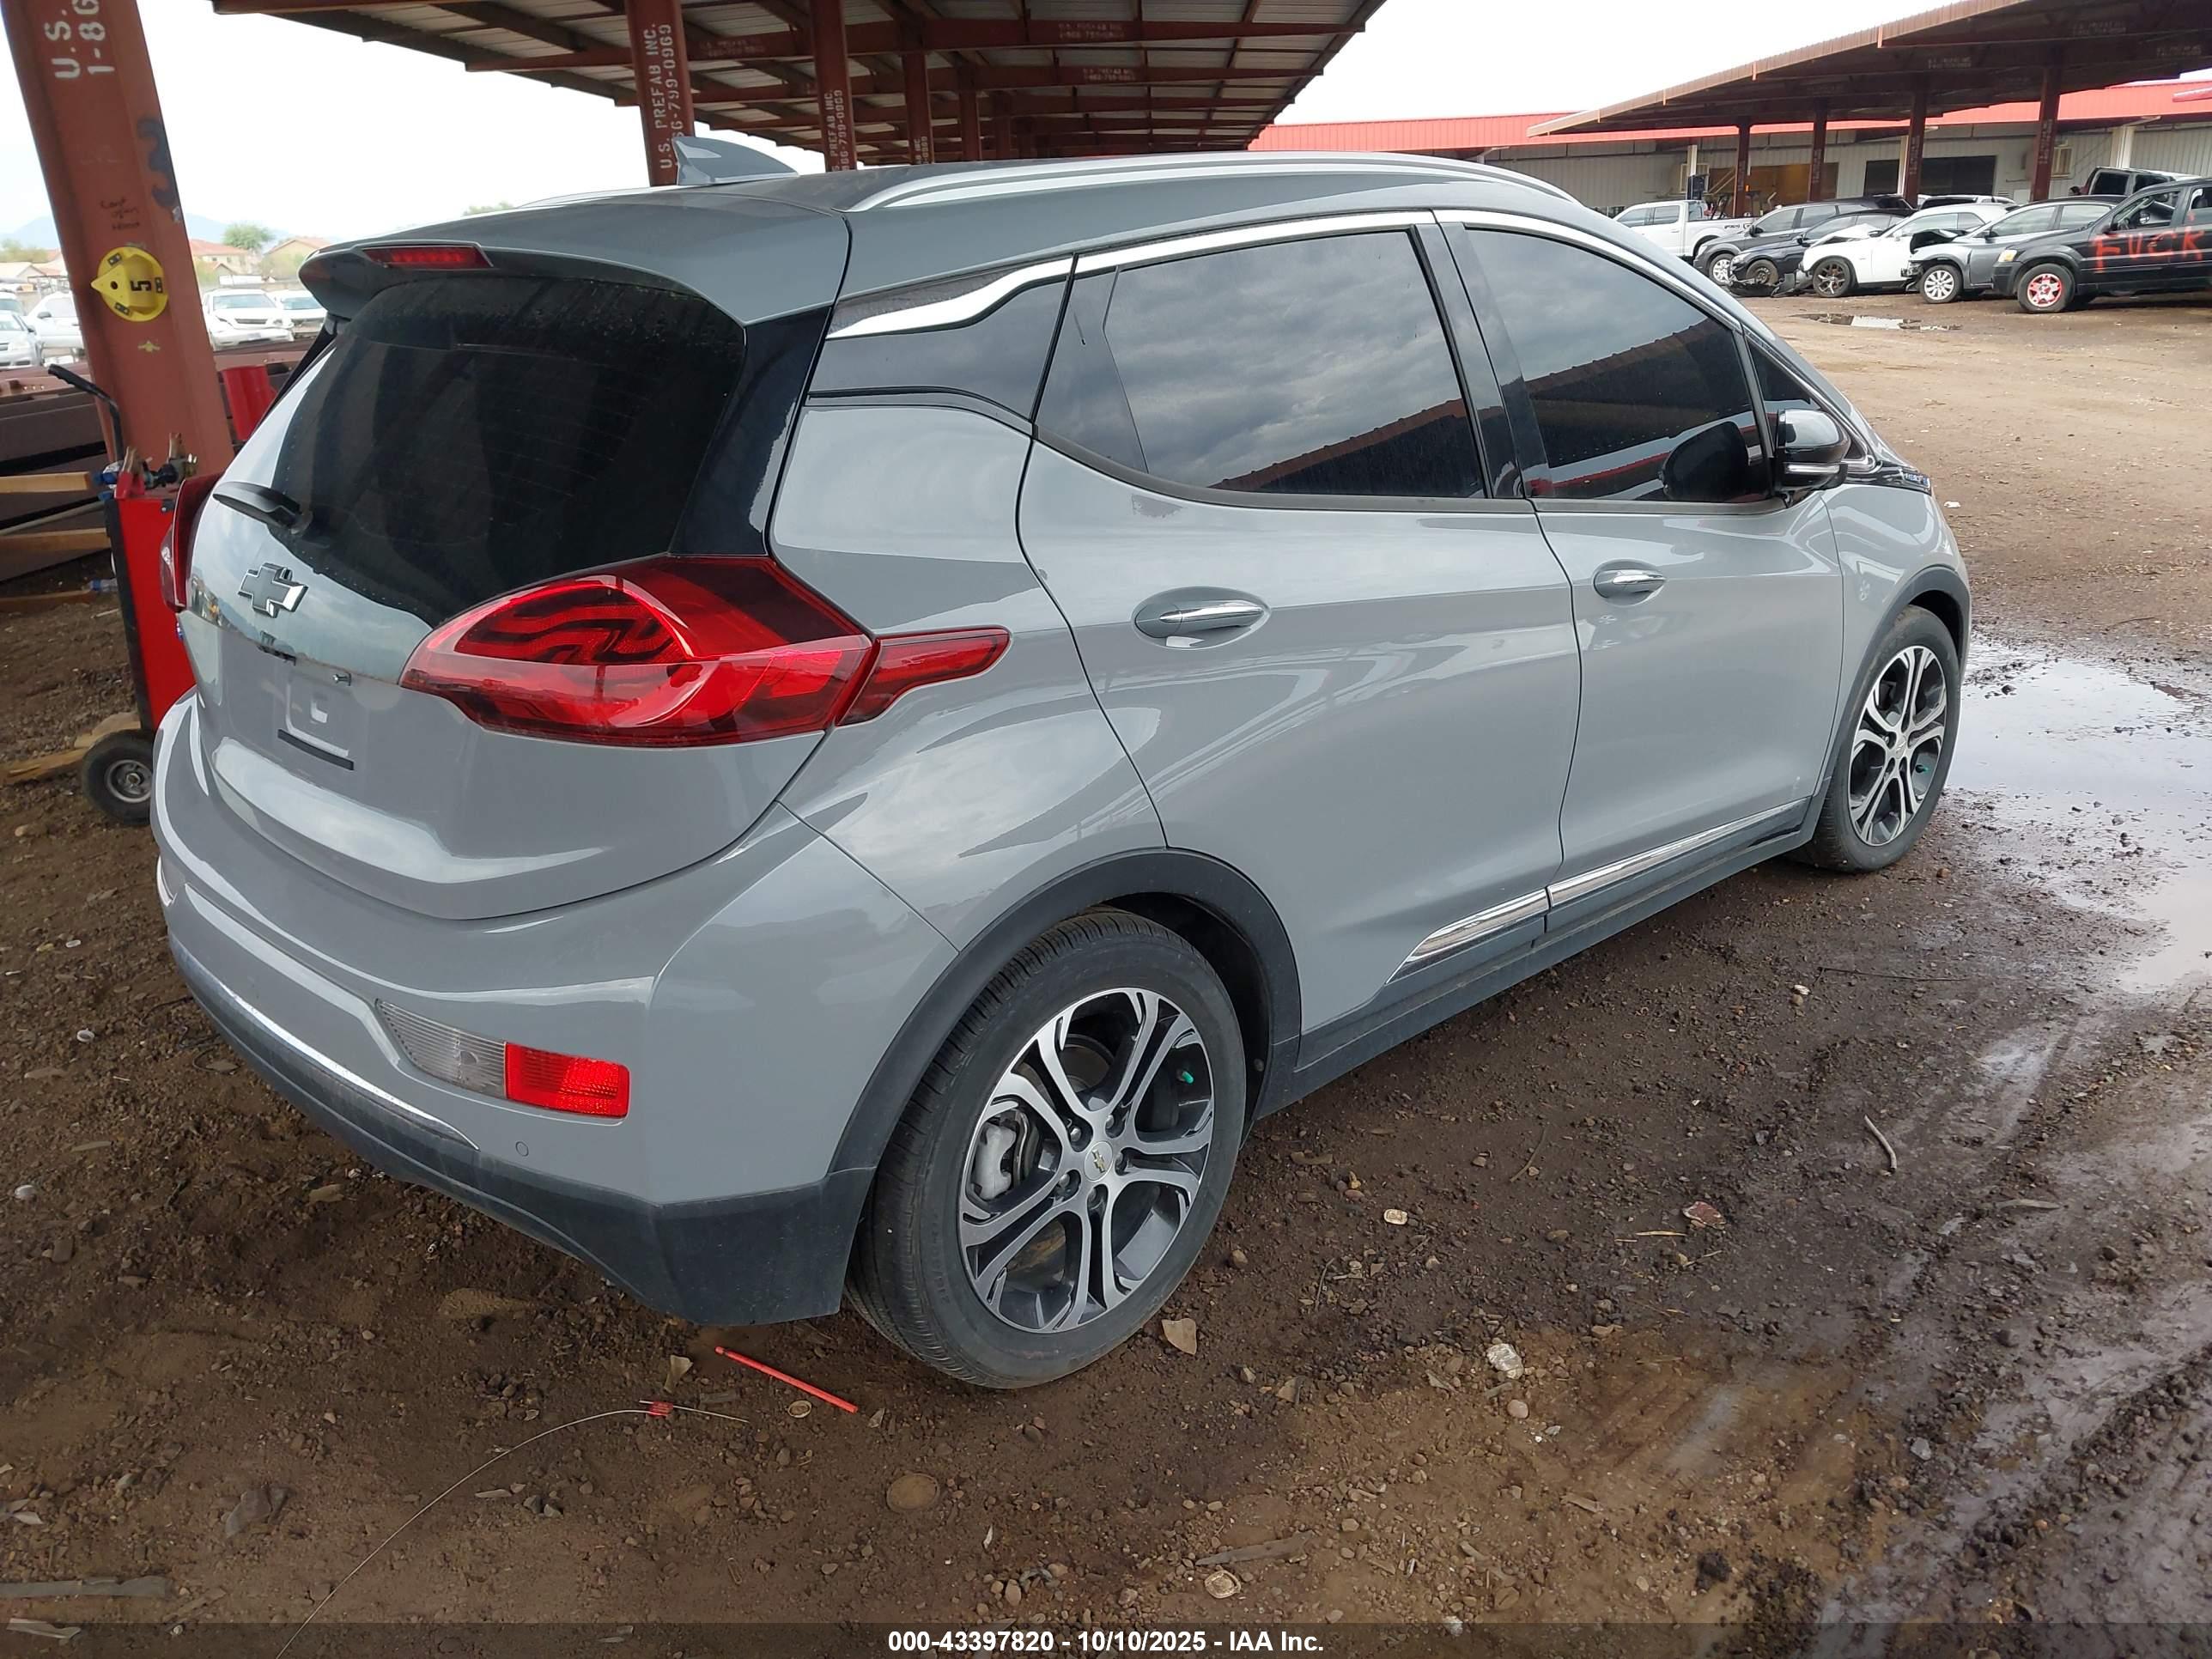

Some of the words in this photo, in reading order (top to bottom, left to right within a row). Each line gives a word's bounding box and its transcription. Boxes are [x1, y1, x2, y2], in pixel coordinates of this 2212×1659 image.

[643, 23, 659, 56] INC.
[648, 64, 668, 129] PREFAB
[658, 137, 673, 169] U.S.
[826, 115, 839, 157] PREFAB
[2093, 225, 2205, 273] FUCK
[130, 280, 152, 292] 5
